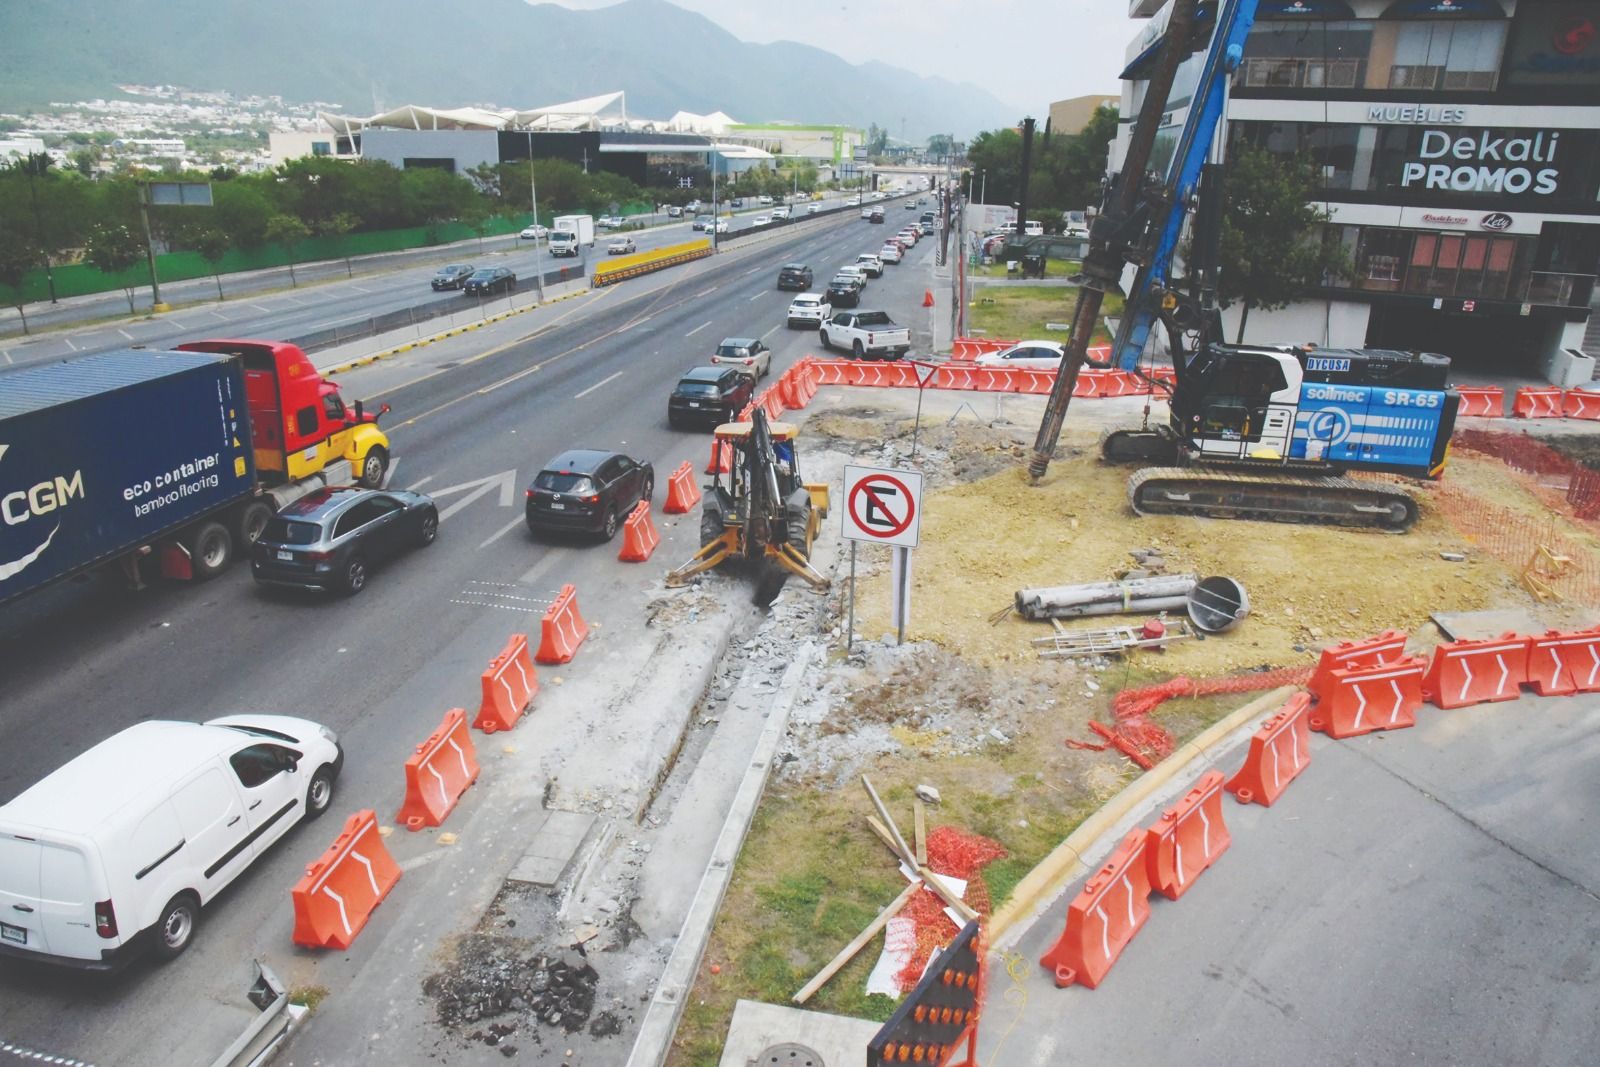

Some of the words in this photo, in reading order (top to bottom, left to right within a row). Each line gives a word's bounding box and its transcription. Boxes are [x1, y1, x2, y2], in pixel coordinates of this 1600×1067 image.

[1367, 106, 1465, 123] MUEBLES
[1419, 130, 1559, 162] Dekali
[1401, 162, 1559, 195] PROMOS
[1307, 358, 1349, 371] DYCUSA
[1306, 387, 1366, 403] soilmec
[1383, 391, 1439, 408] SR-65
[123, 480, 152, 501] eco
[155, 452, 219, 488] container
[1, 469, 85, 525] CGM
[134, 490, 179, 517] bamboo
[179, 473, 219, 498] flooring
